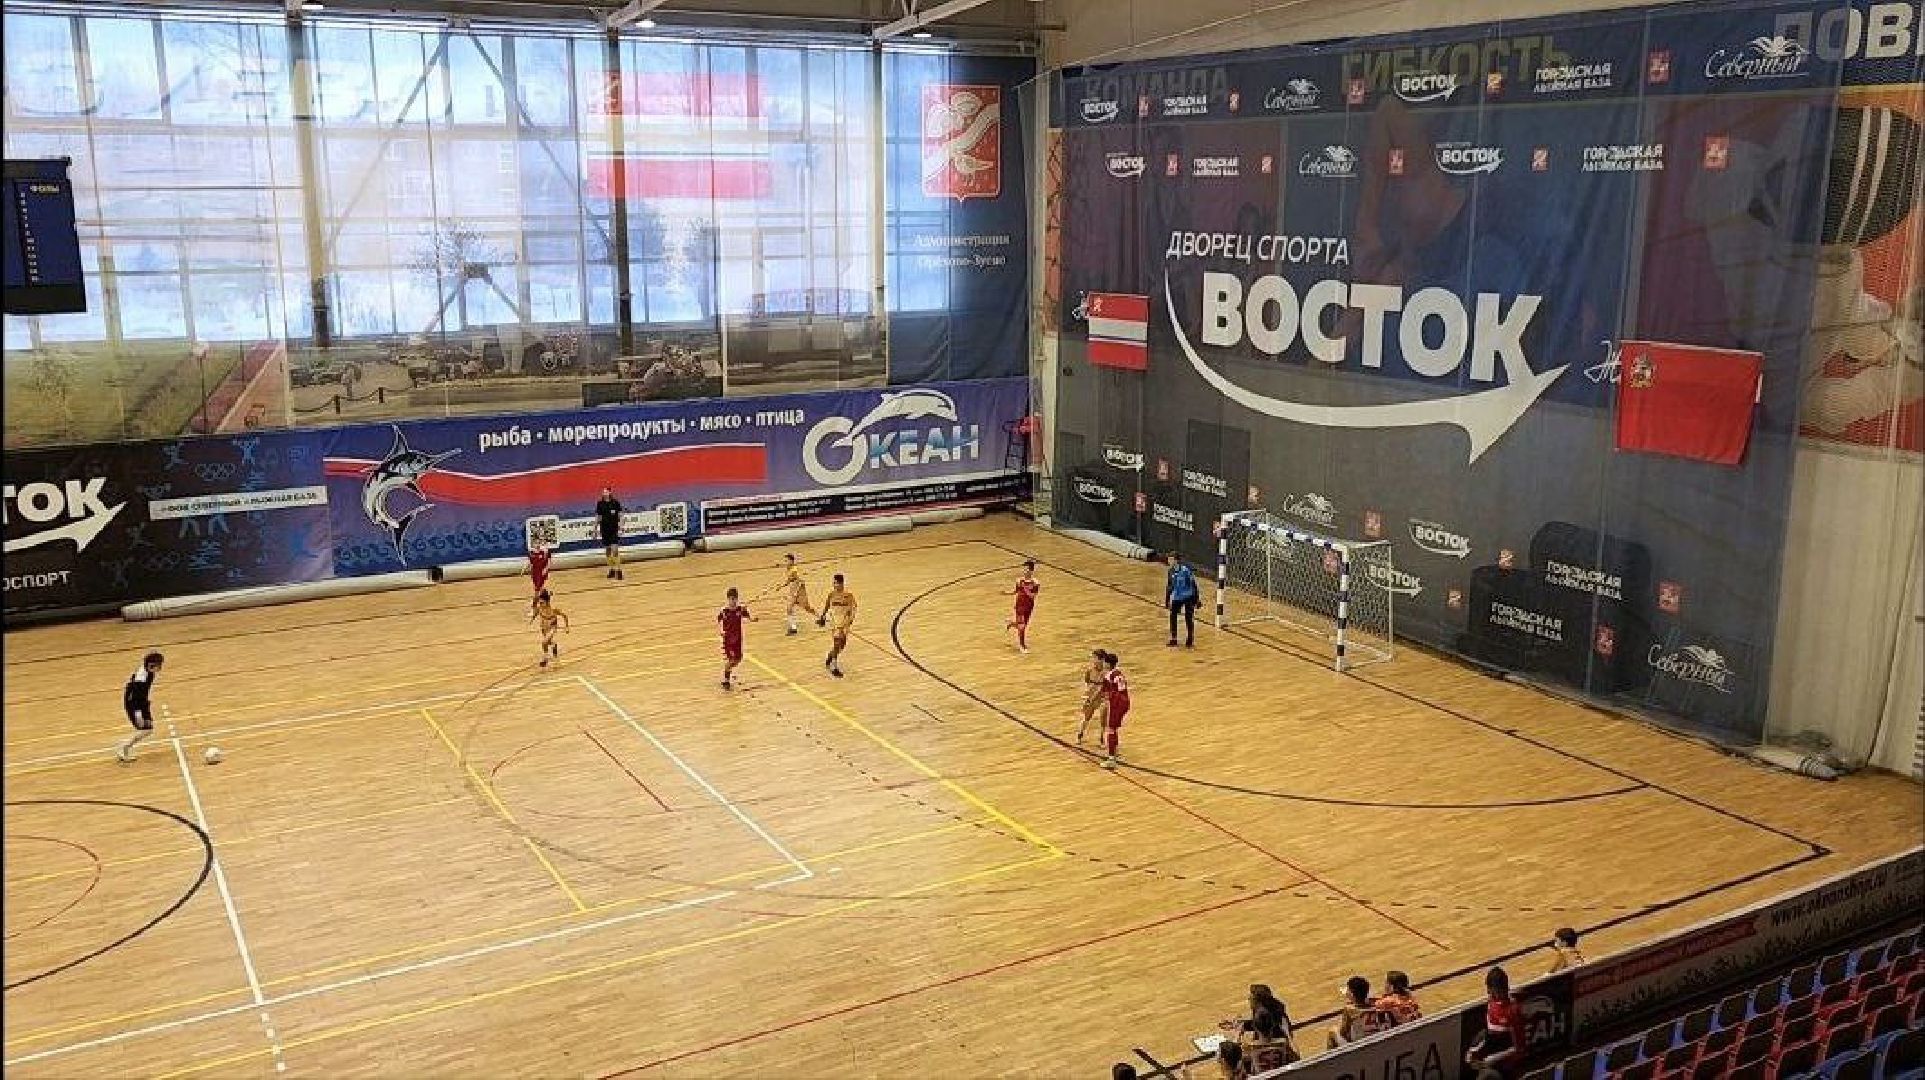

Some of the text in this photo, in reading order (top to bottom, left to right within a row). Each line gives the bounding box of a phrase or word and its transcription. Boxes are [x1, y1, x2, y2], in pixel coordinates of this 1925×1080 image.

[1402, 74, 1456, 92] ВОСТОК
[1442, 148, 1500, 163] ВОСТОК
[1165, 231, 1349, 265] ДВОРЕЦ СПОРТА
[1202, 272, 1543, 388] ВОСТОК
[479, 408, 804, 452] рыба морепродукты мясо птица
[803, 416, 979, 485] ОКЕАН
[1415, 525, 1470, 550] ВОСТОК
